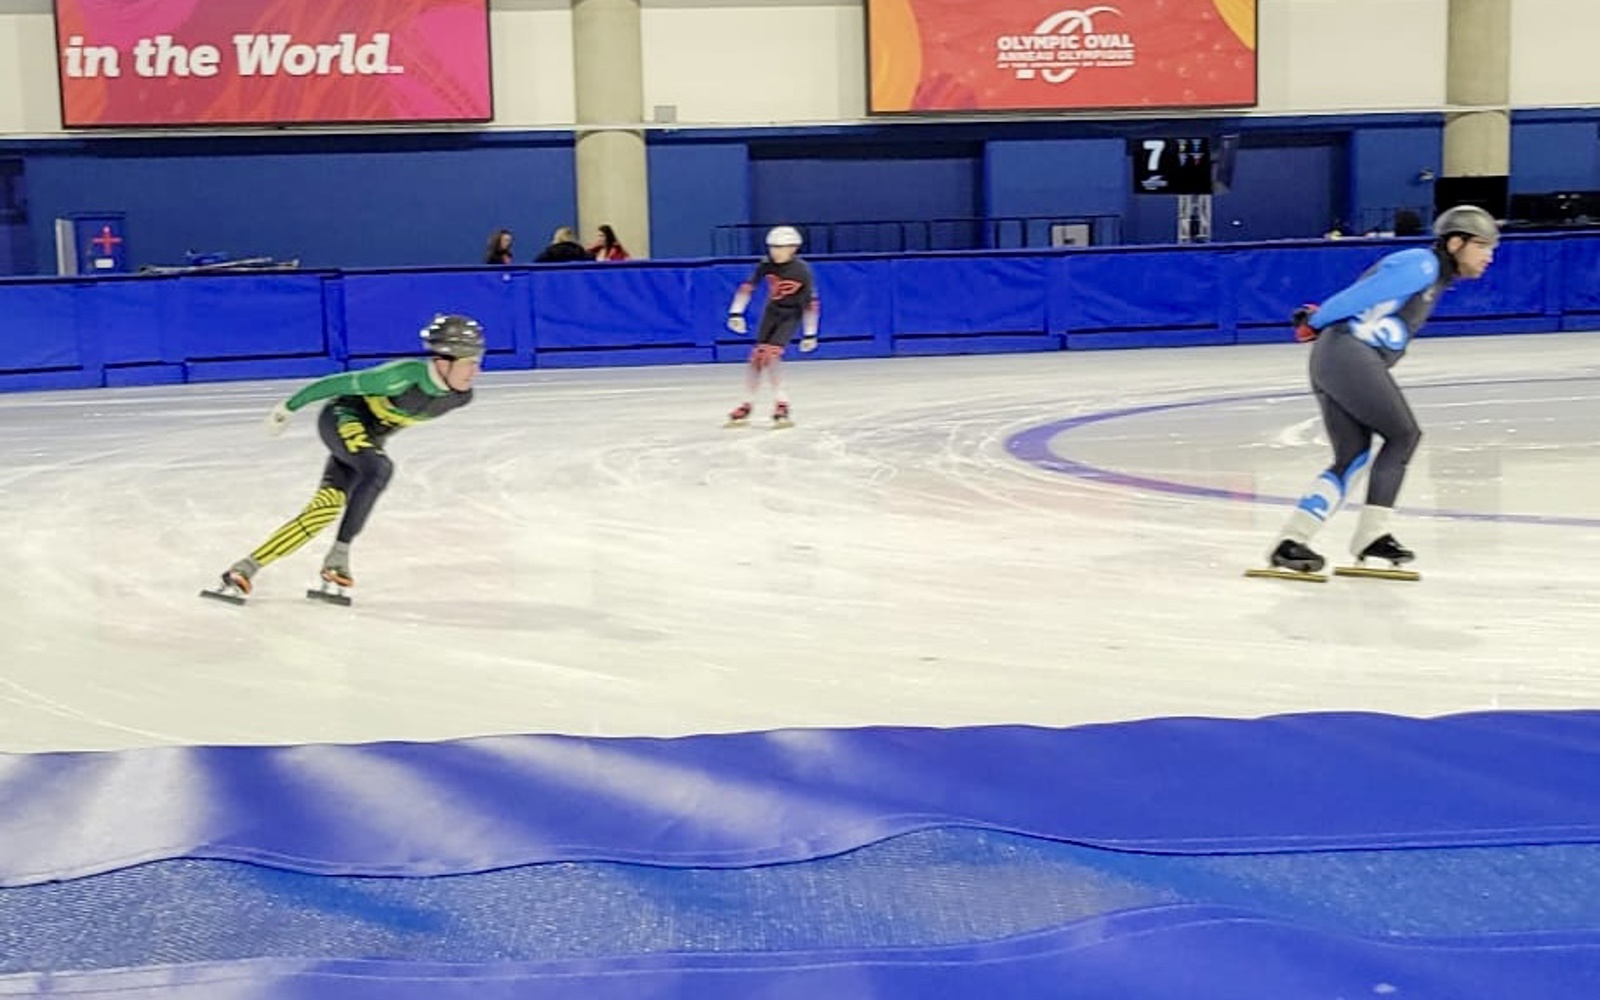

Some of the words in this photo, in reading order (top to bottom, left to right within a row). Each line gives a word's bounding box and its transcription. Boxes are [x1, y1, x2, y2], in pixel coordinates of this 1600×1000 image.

[65, 36, 120, 77] in
[133, 36, 221, 77] the
[997, 35, 1080, 50] OLYMPIC
[1084, 34, 1135, 49] OVAL
[1142, 140, 1166, 171] 7
